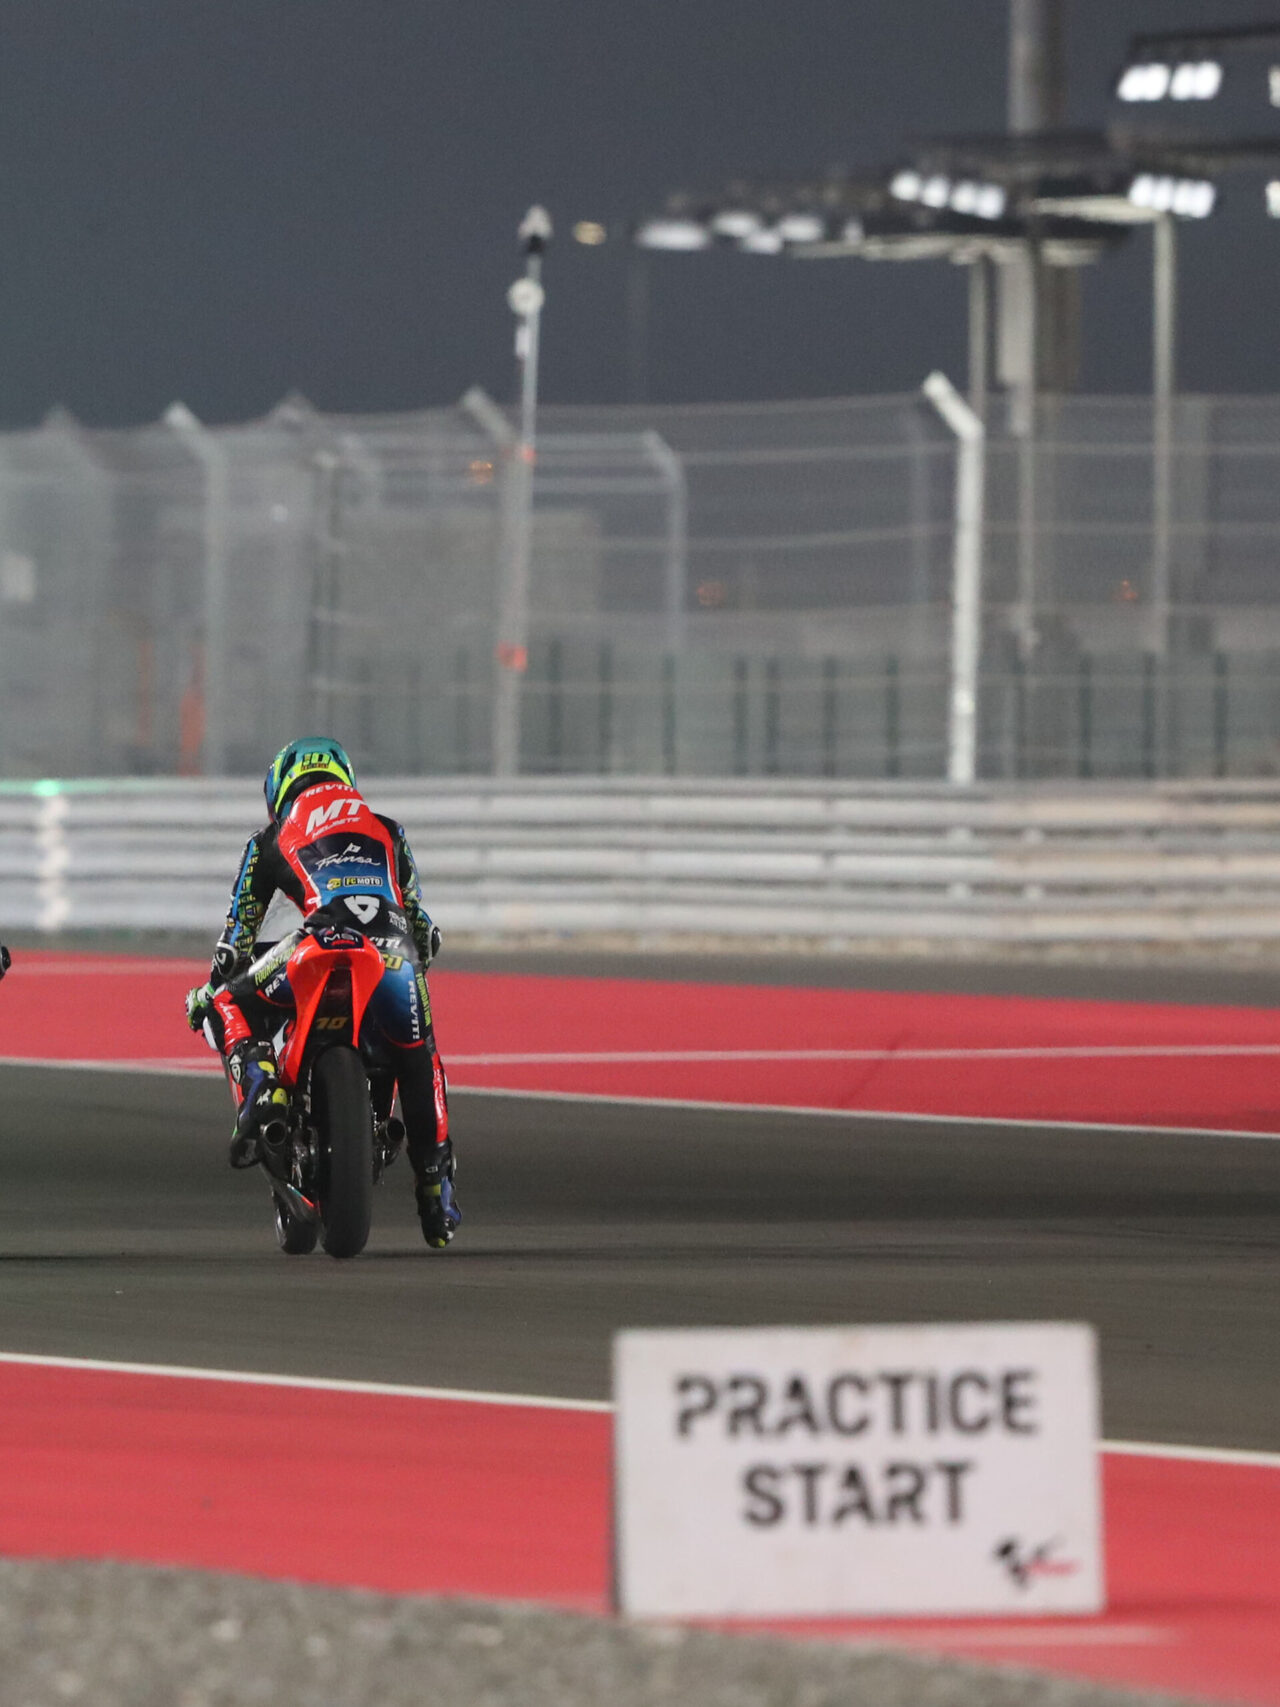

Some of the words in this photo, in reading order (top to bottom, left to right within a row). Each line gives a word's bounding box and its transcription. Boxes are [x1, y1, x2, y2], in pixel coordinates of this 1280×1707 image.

[305, 798, 363, 837] MT
[408, 980, 420, 1040] REV'IT!
[674, 1370, 1039, 1440] PRACTICE
[742, 1462, 975, 1528] START
